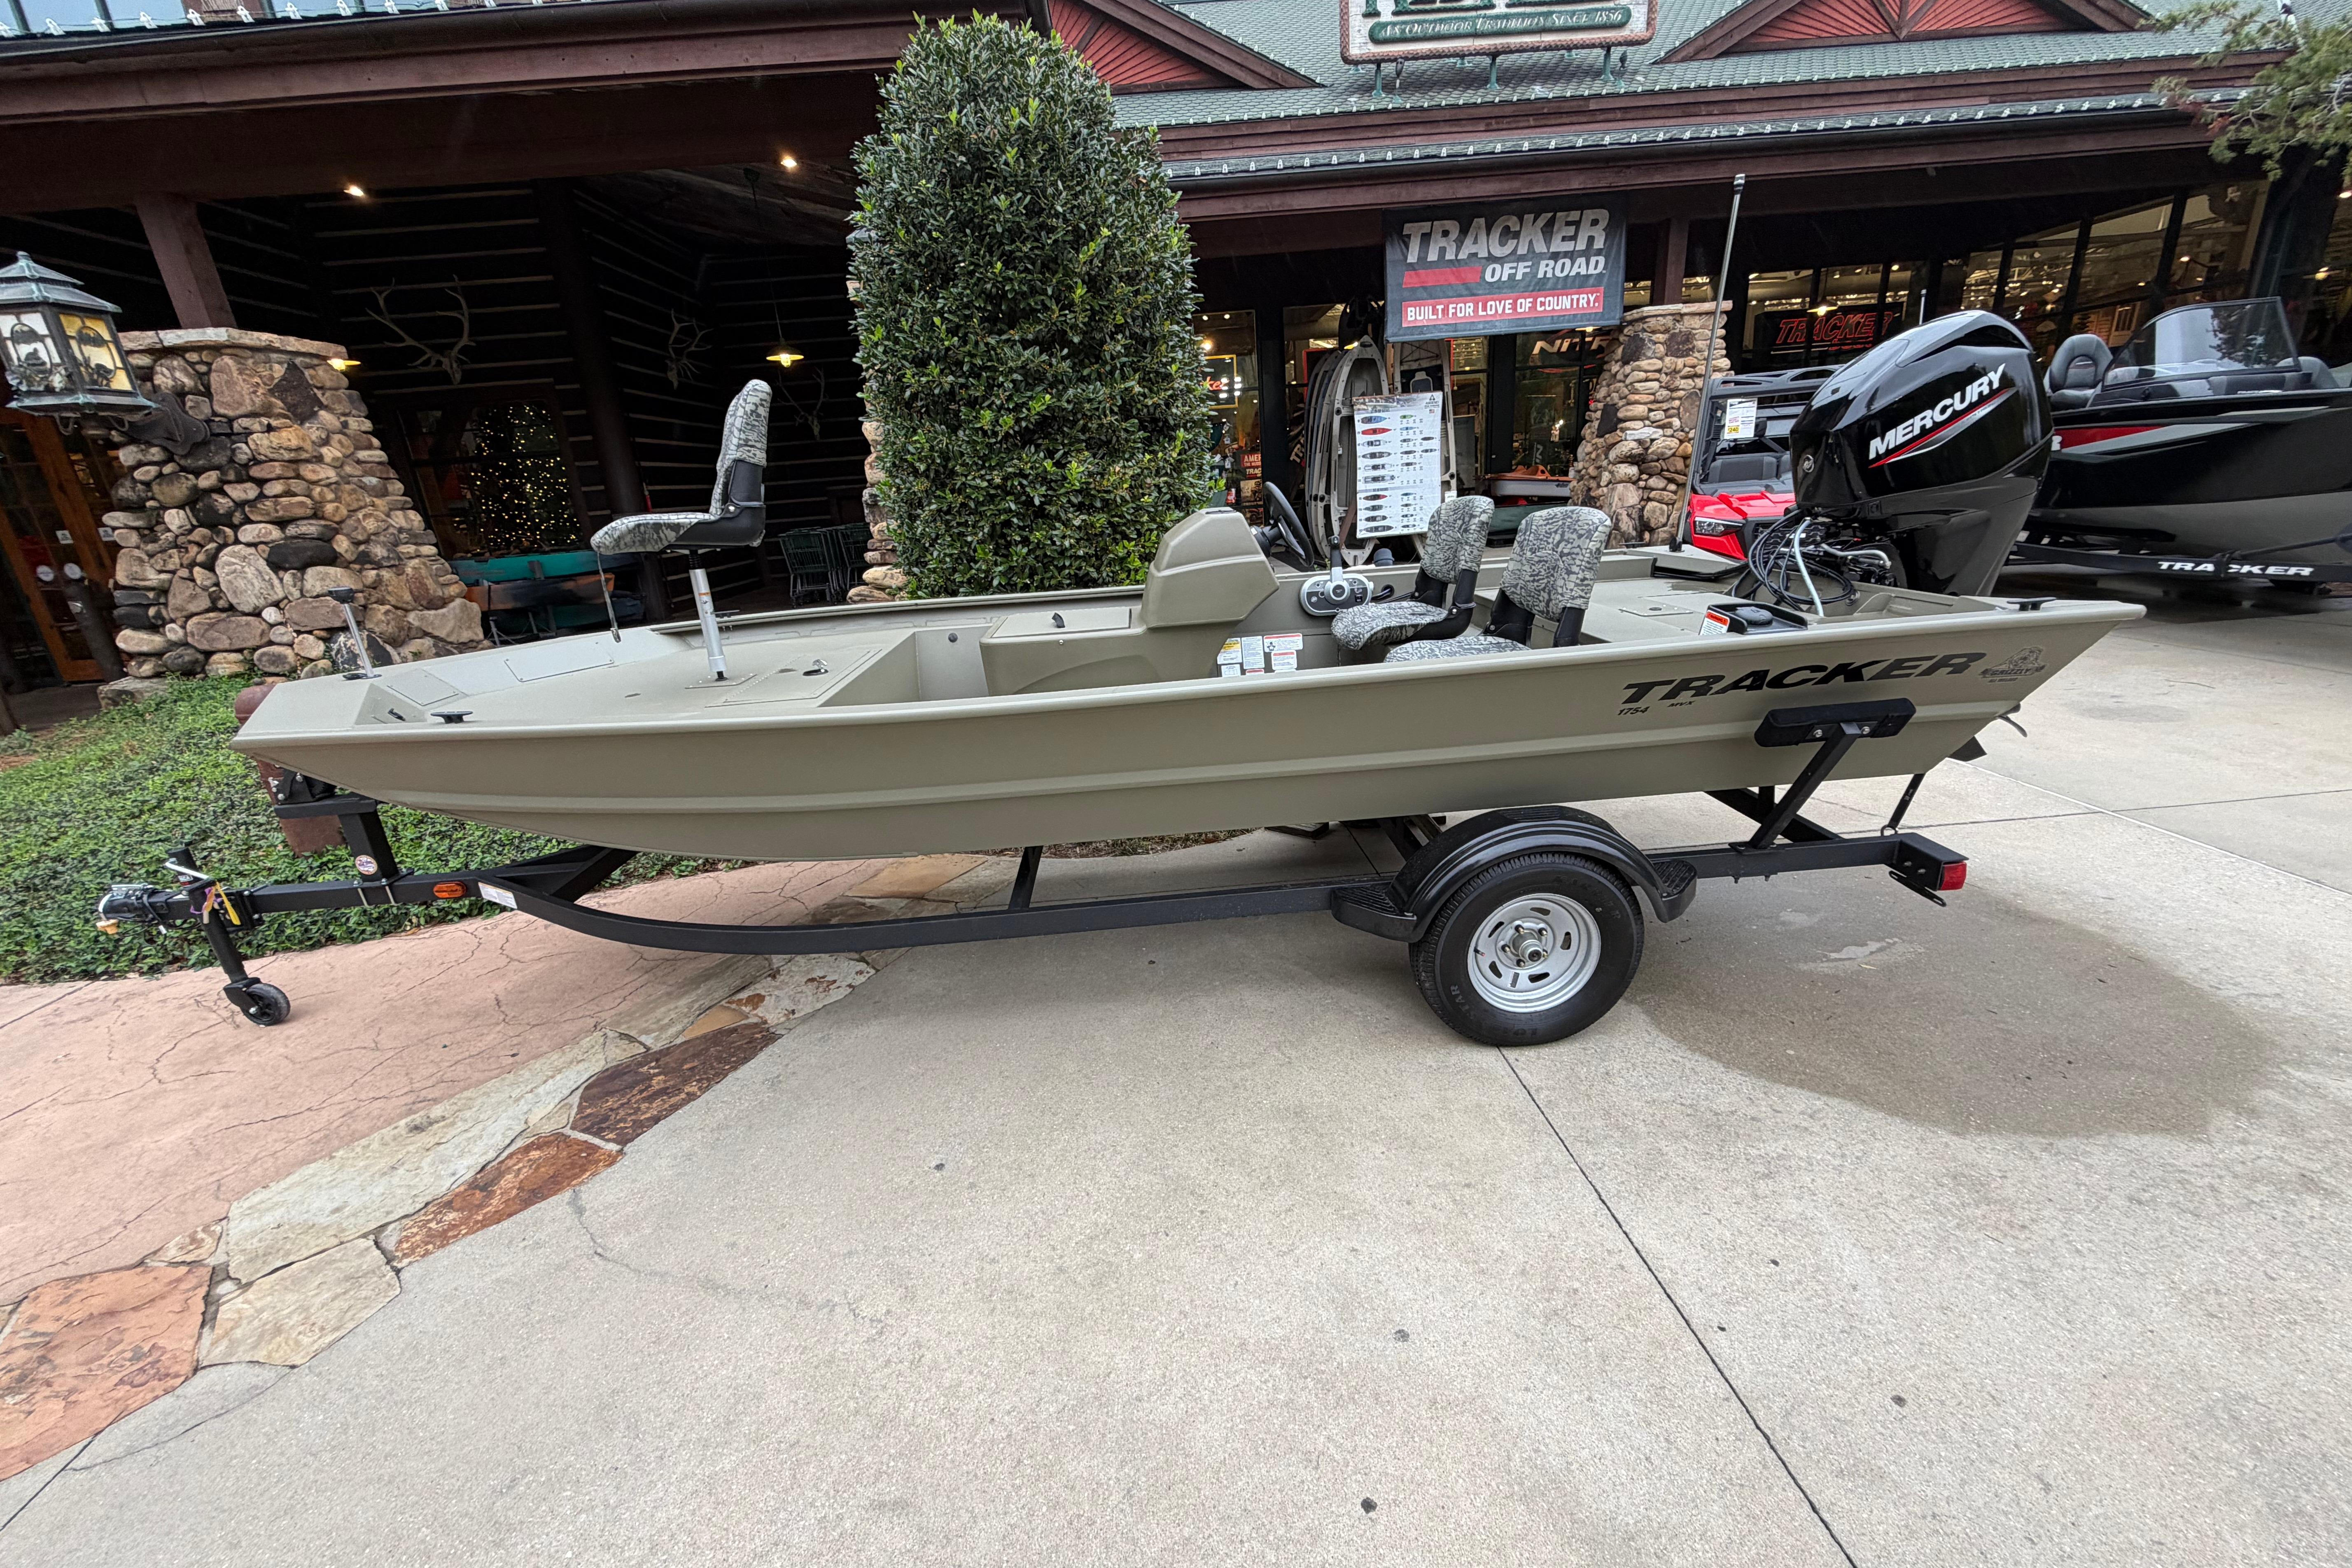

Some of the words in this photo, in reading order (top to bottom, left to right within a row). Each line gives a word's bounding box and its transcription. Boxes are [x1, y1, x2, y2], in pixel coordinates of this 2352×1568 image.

[1595, 10, 1623, 23] 1856
[1402, 209, 1609, 263] TRACKER
[1485, 261, 1532, 282] OFF
[1407, 303, 1444, 321] BUILT
[1449, 303, 1474, 318] FOR
[1478, 299, 1513, 315] LOVE
[1517, 298, 1533, 312] OF
[1869, 363, 2006, 460] MERCURY
[1621, 652, 1986, 705] TRACKER
[1617, 706, 1650, 716] 1754
